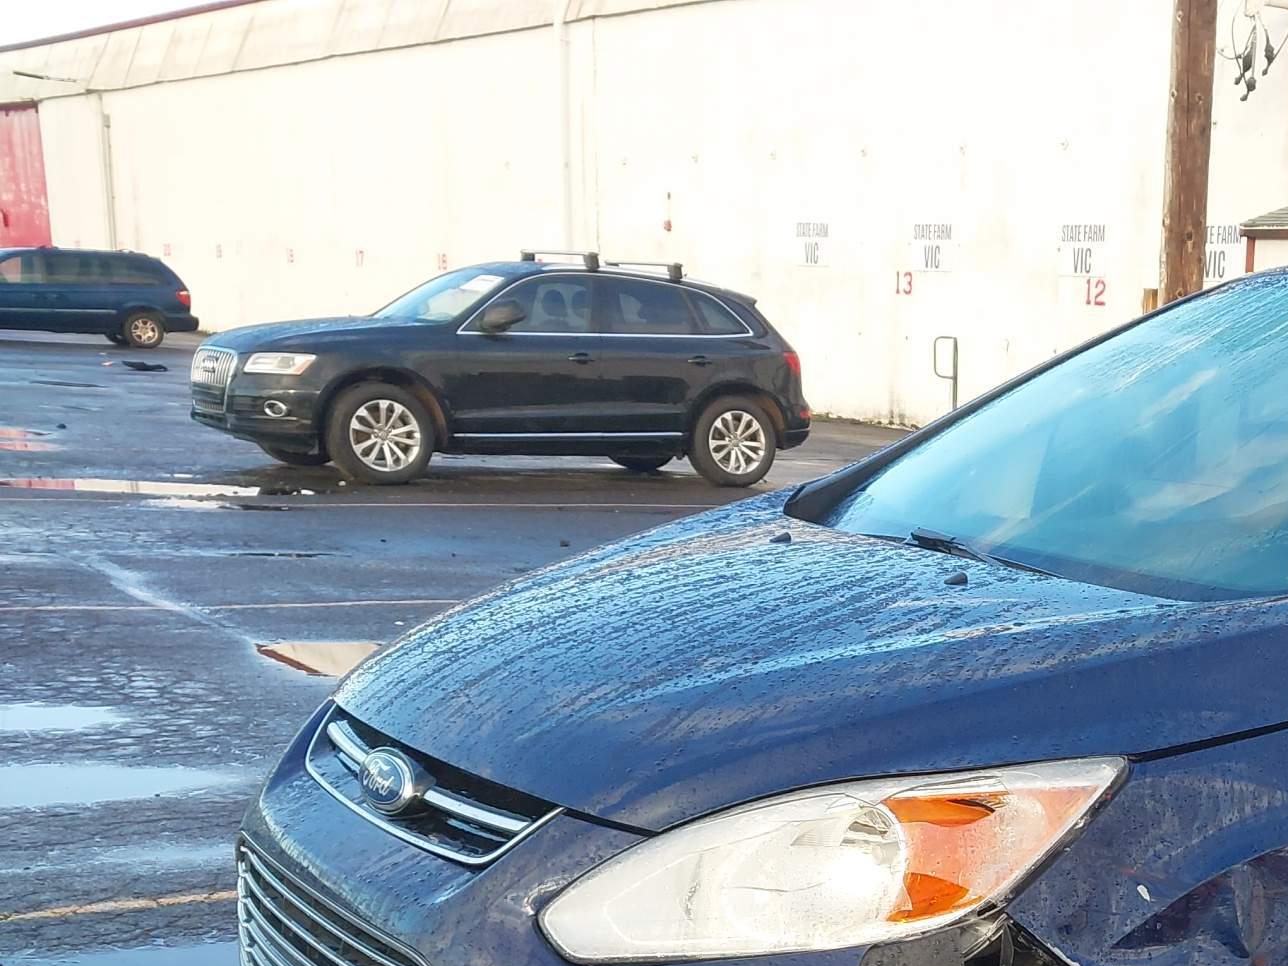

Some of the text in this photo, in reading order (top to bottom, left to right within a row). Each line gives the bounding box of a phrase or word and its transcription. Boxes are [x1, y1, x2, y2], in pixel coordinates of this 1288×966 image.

[914, 224, 952, 240] STATE FARM
[1061, 225, 1105, 243] STATE FARM
[1217, 225, 1241, 245] FARM
[804, 242, 819, 264] VIC
[924, 245, 940, 269] VIC
[1073, 248, 1092, 274] VIC
[1204, 250, 1225, 278] VIC
[895, 271, 913, 295] 13
[1085, 278, 1106, 306] 12
[363, 758, 395, 797] Ford
